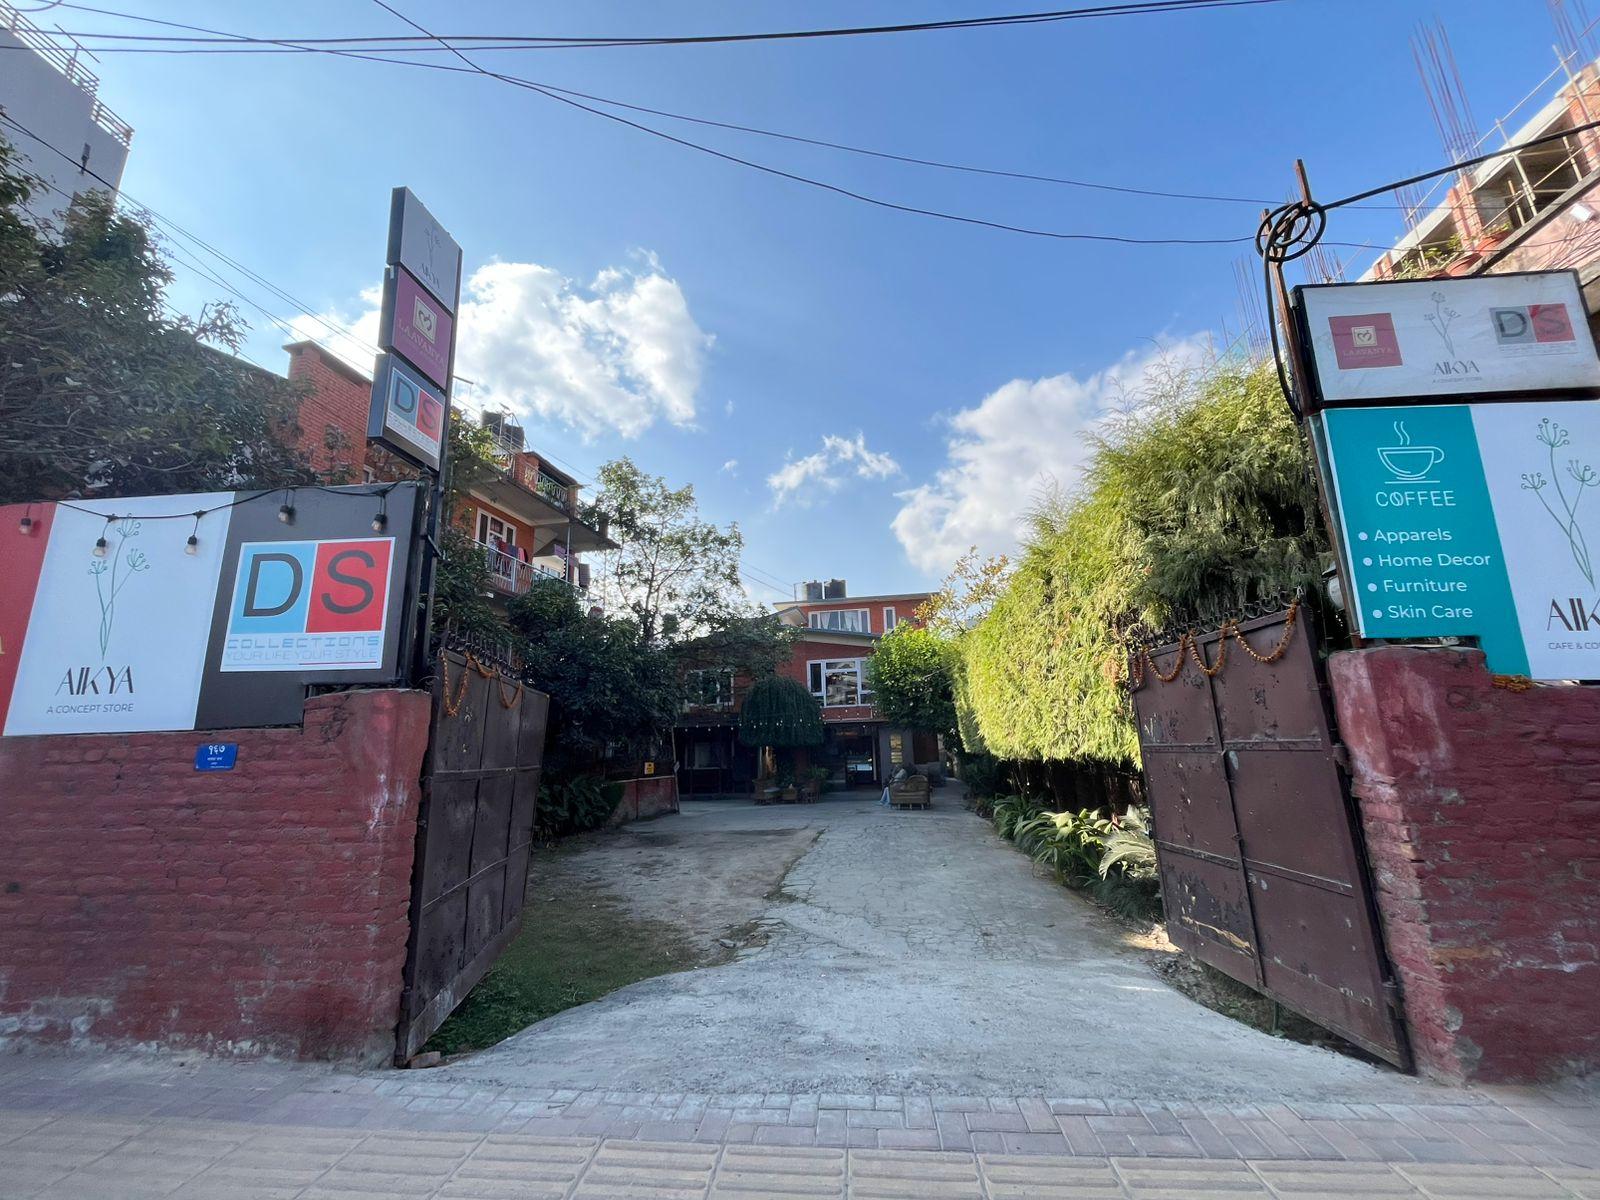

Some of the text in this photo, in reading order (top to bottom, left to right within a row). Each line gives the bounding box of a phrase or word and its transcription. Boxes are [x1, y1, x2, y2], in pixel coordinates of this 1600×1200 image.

[1433, 360, 1480, 375] AIKYA
[1375, 490, 1456, 507] COFFEE
[1374, 528, 1453, 544] Apparels
[1378, 553, 1491, 567] Home Decor
[1383, 579, 1467, 592] Furniture
[1388, 605, 1473, 618] Skin Care
[227, 636, 379, 649] COLLECTIONS
[1548, 642, 1600, 650] CAFE & CO
[227, 649, 378, 661] YOUR LIFE YOUR STYLE
[55, 665, 134, 696] AIKYA
[46, 703, 134, 714] A CONCEPT STORE
